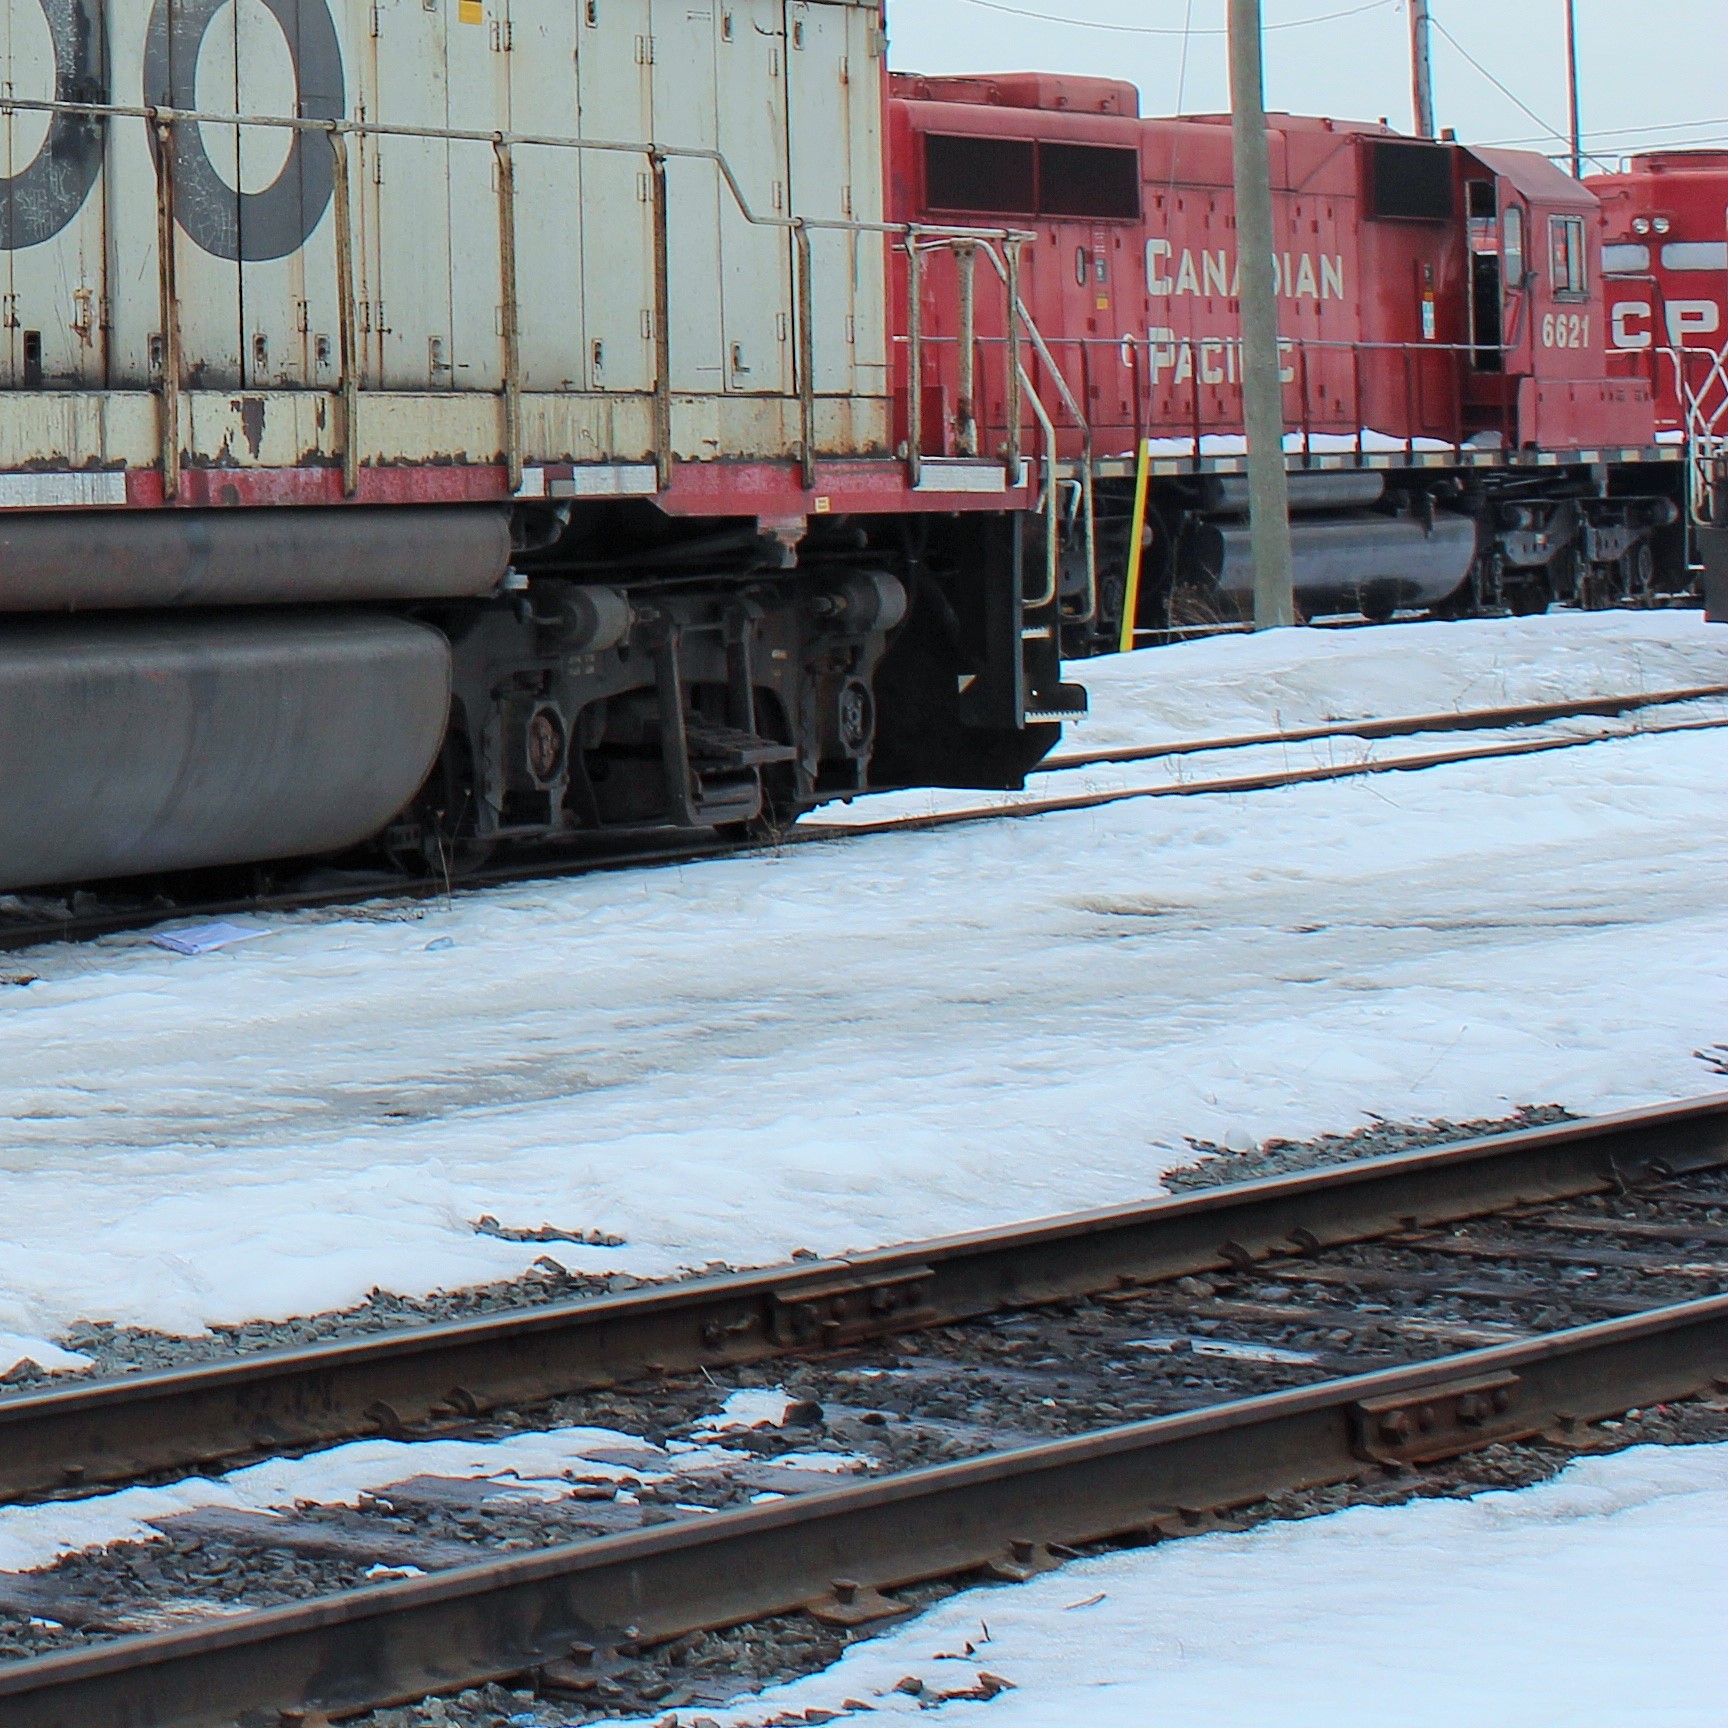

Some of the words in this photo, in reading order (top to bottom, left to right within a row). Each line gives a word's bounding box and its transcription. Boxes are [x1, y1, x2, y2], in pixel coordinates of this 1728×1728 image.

[1146, 239, 1343, 300] CANIAN
[1543, 313, 1590, 348] 6621
[1612, 300, 1720, 348] CP
[1148, 327, 1294, 384] PACIC
